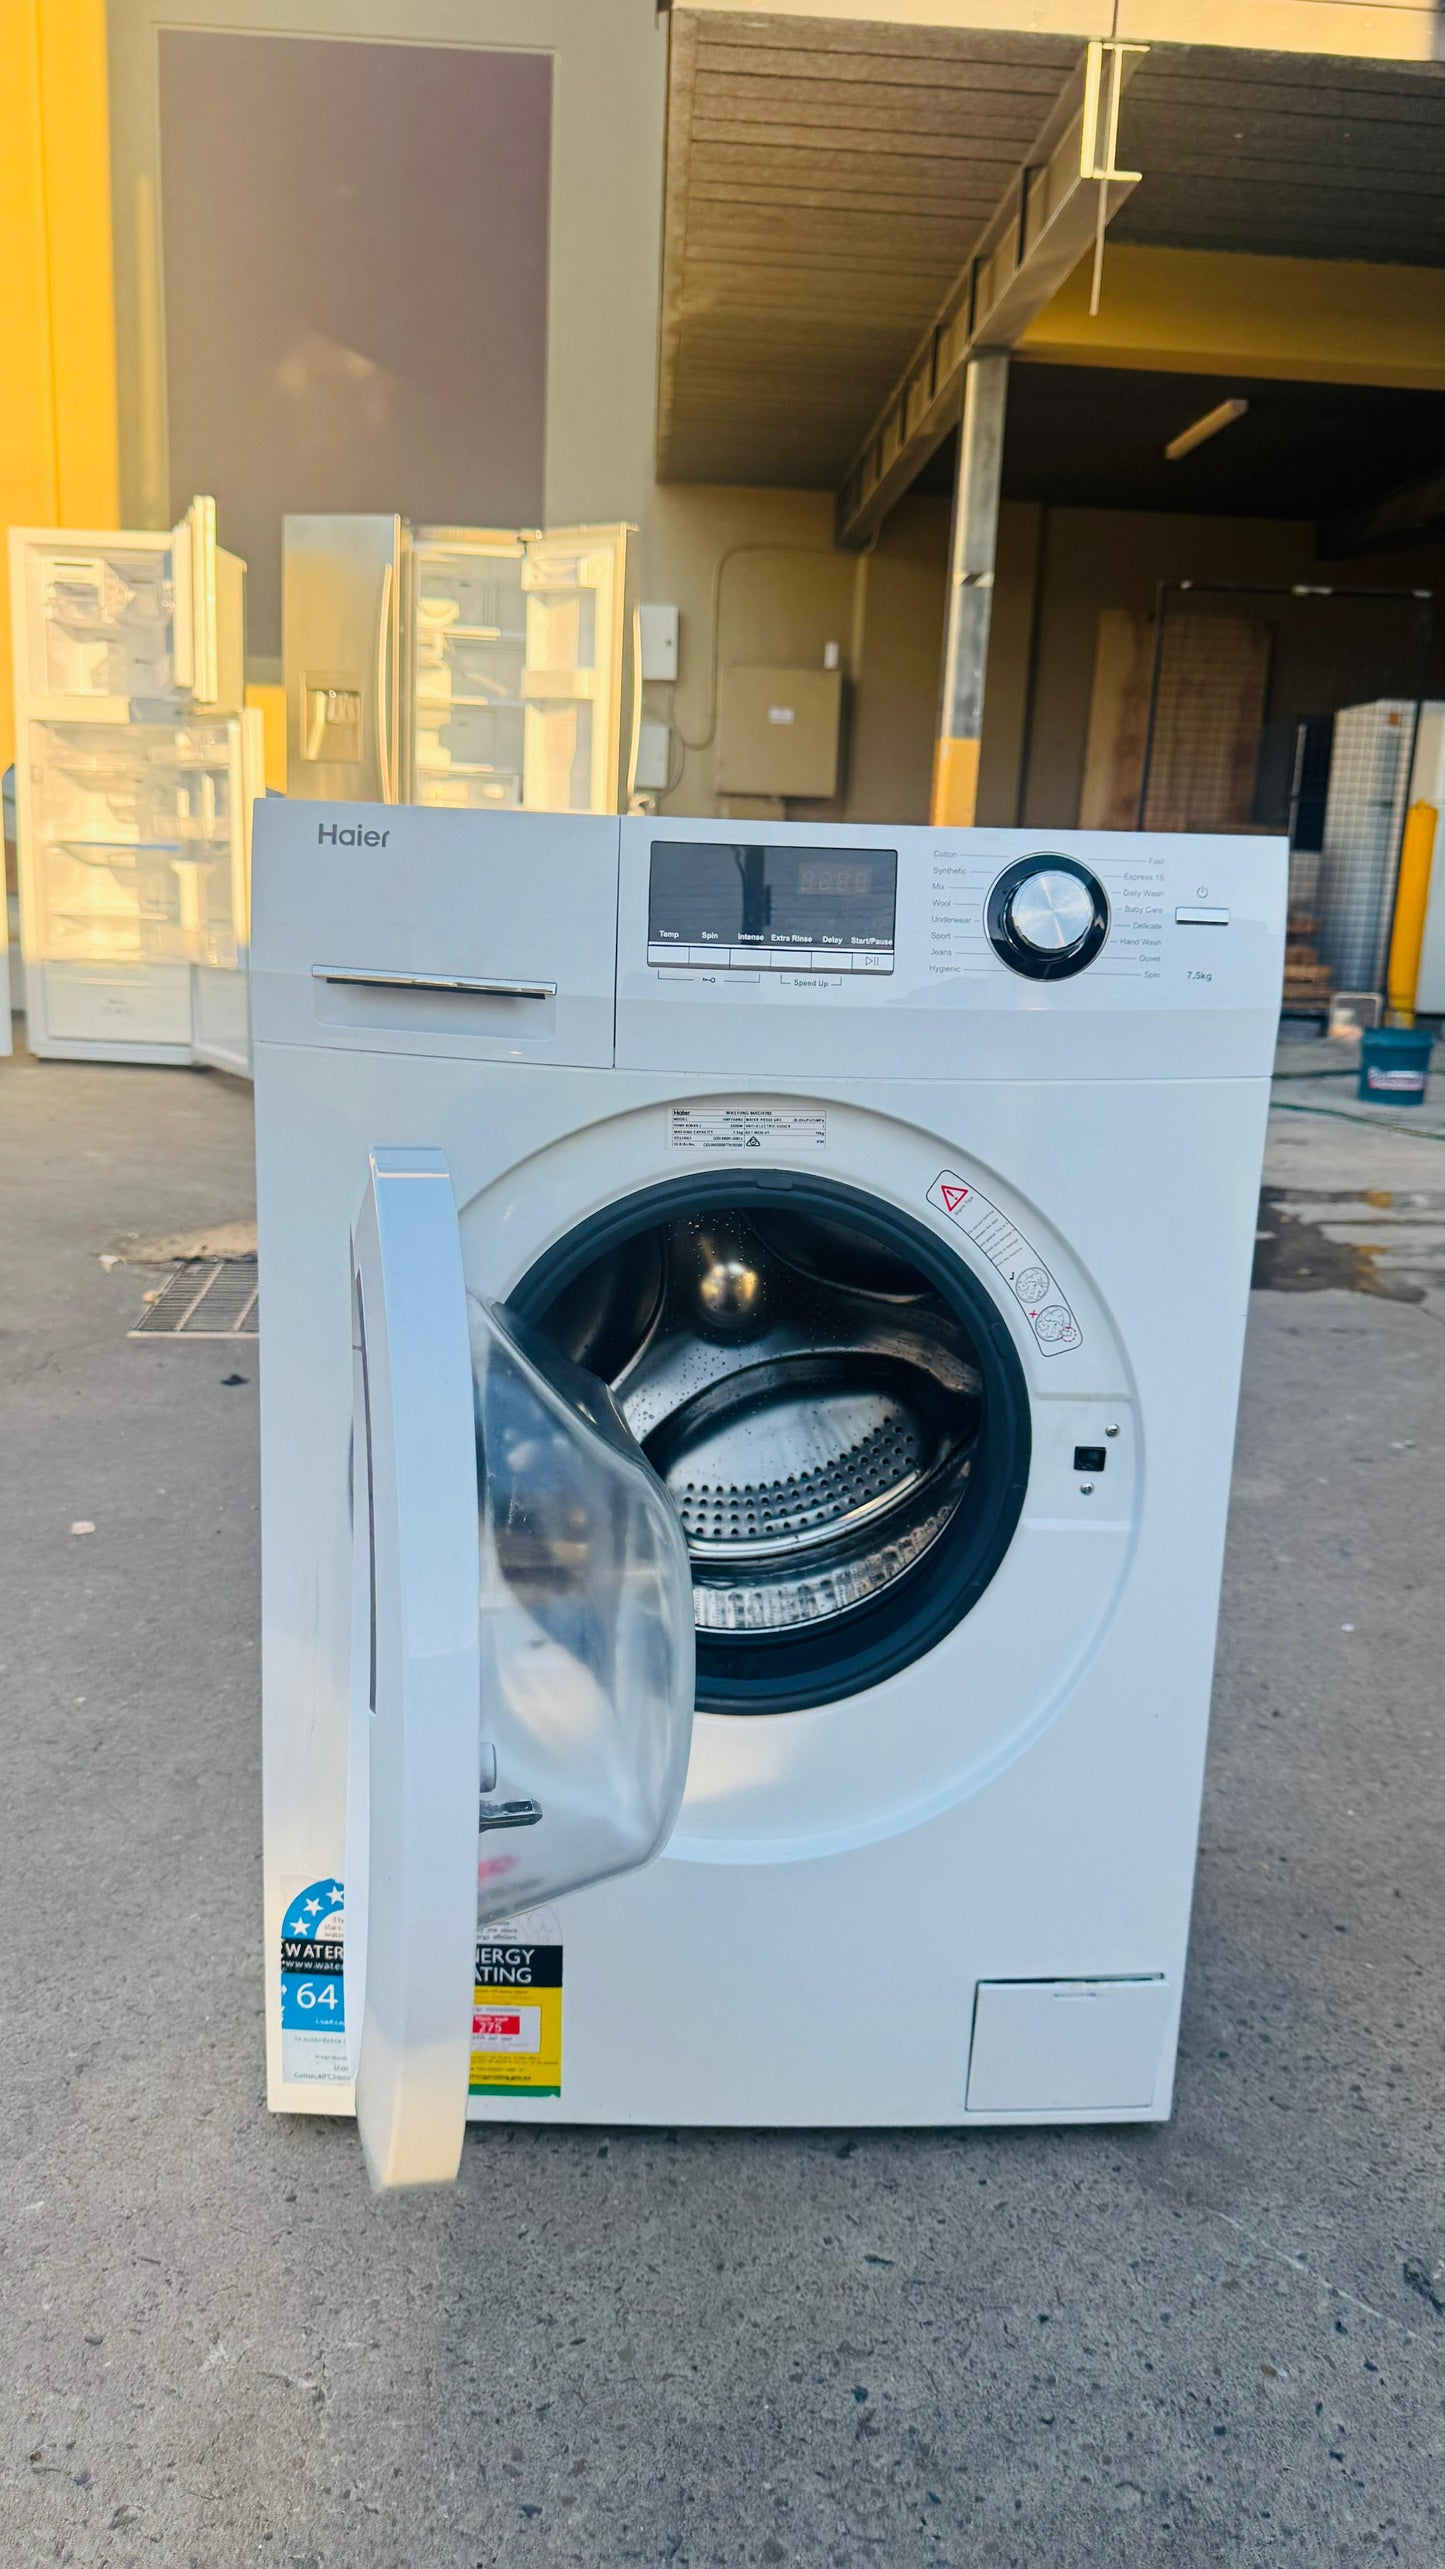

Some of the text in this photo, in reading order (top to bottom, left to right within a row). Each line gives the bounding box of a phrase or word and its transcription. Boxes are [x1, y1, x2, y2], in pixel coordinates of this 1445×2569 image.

[318, 822, 391, 848] Haier
[933, 850, 958, 858] Cotton
[1148, 857, 1165, 865] Fast
[933, 866, 967, 876] Synthetic
[1123, 873, 1165, 882] Express 15
[932, 882, 945, 890] Mix
[1123, 889, 1164, 898] Daily Wash
[932, 899, 951, 907] Wool
[1124, 905, 1163, 915] Baby Care
[931, 915, 971, 924] Underwear
[1133, 921, 1162, 930] Delicate
[659, 930, 679, 939] Temp
[701, 931, 718, 940] Spin
[737, 932, 765, 941] Intense
[771, 934, 813, 943] Extra Rinse
[930, 931, 951, 941] Sport
[822, 935, 843, 945] Delay
[851, 936, 893, 946] Start/Pause
[1120, 938, 1162, 946] Hand Wash
[930, 948, 953, 957] Jeans
[1139, 954, 1161, 962] Duvet
[929, 964, 961, 974] Hygienic
[1143, 971, 1161, 979] Spin
[1186, 970, 1213, 981] 7.5kg
[794, 979, 829, 988] Speed Up
[285, 1942, 344, 1960] WATER
[296, 1982, 339, 2011] 64
